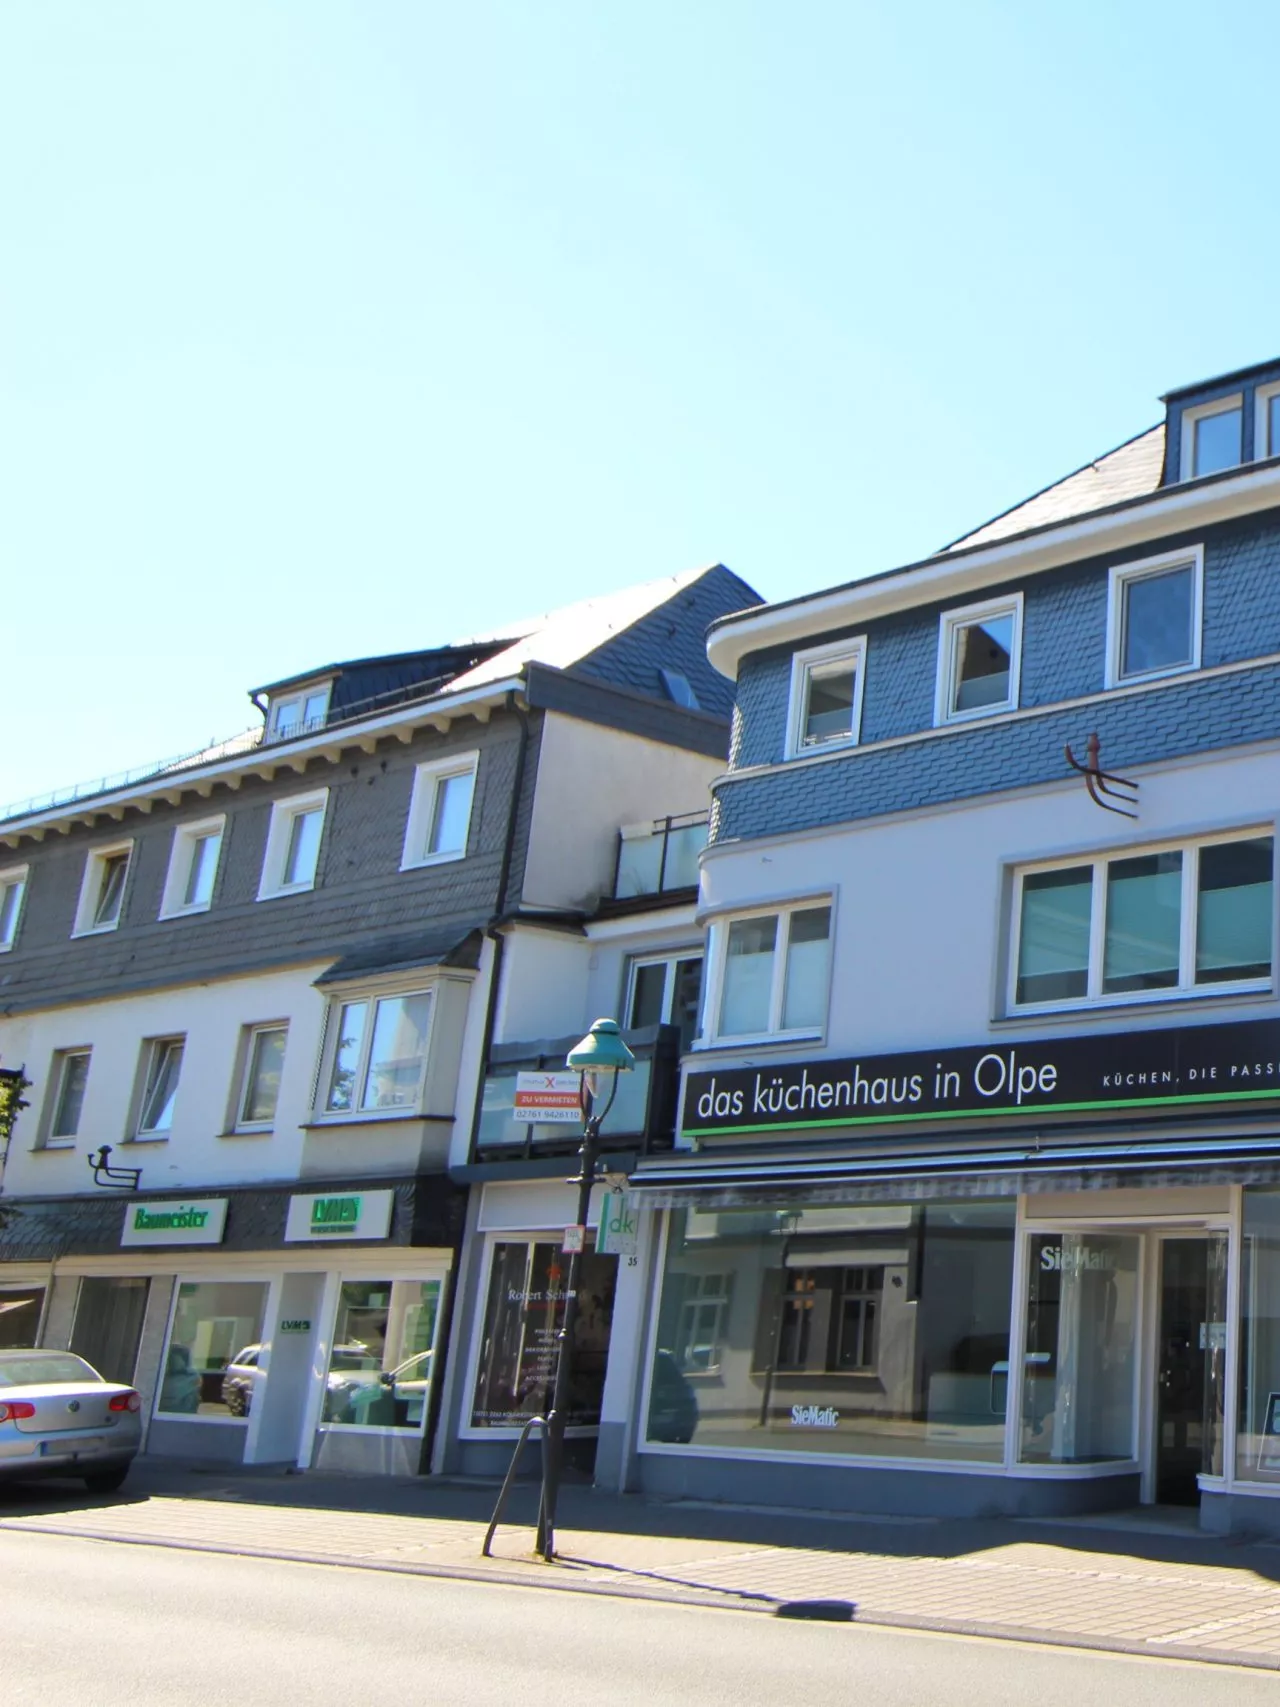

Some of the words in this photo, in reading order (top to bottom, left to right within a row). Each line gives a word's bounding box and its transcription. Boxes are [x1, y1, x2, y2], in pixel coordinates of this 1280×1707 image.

[697, 1077, 744, 1119] das
[753, 1064, 923, 1114] küchenhaus
[934, 1062, 961, 1099] in
[973, 1050, 1059, 1105] Olpe
[1103, 1070, 1180, 1087] KÜCHEN,
[1189, 1066, 1218, 1081] DIE
[521, 1095, 533, 1104] ZU
[534, 1095, 578, 1104] VERMIETEN
[133, 1205, 209, 1231] Baumeister
[791, 1404, 840, 1427] SieMatic
